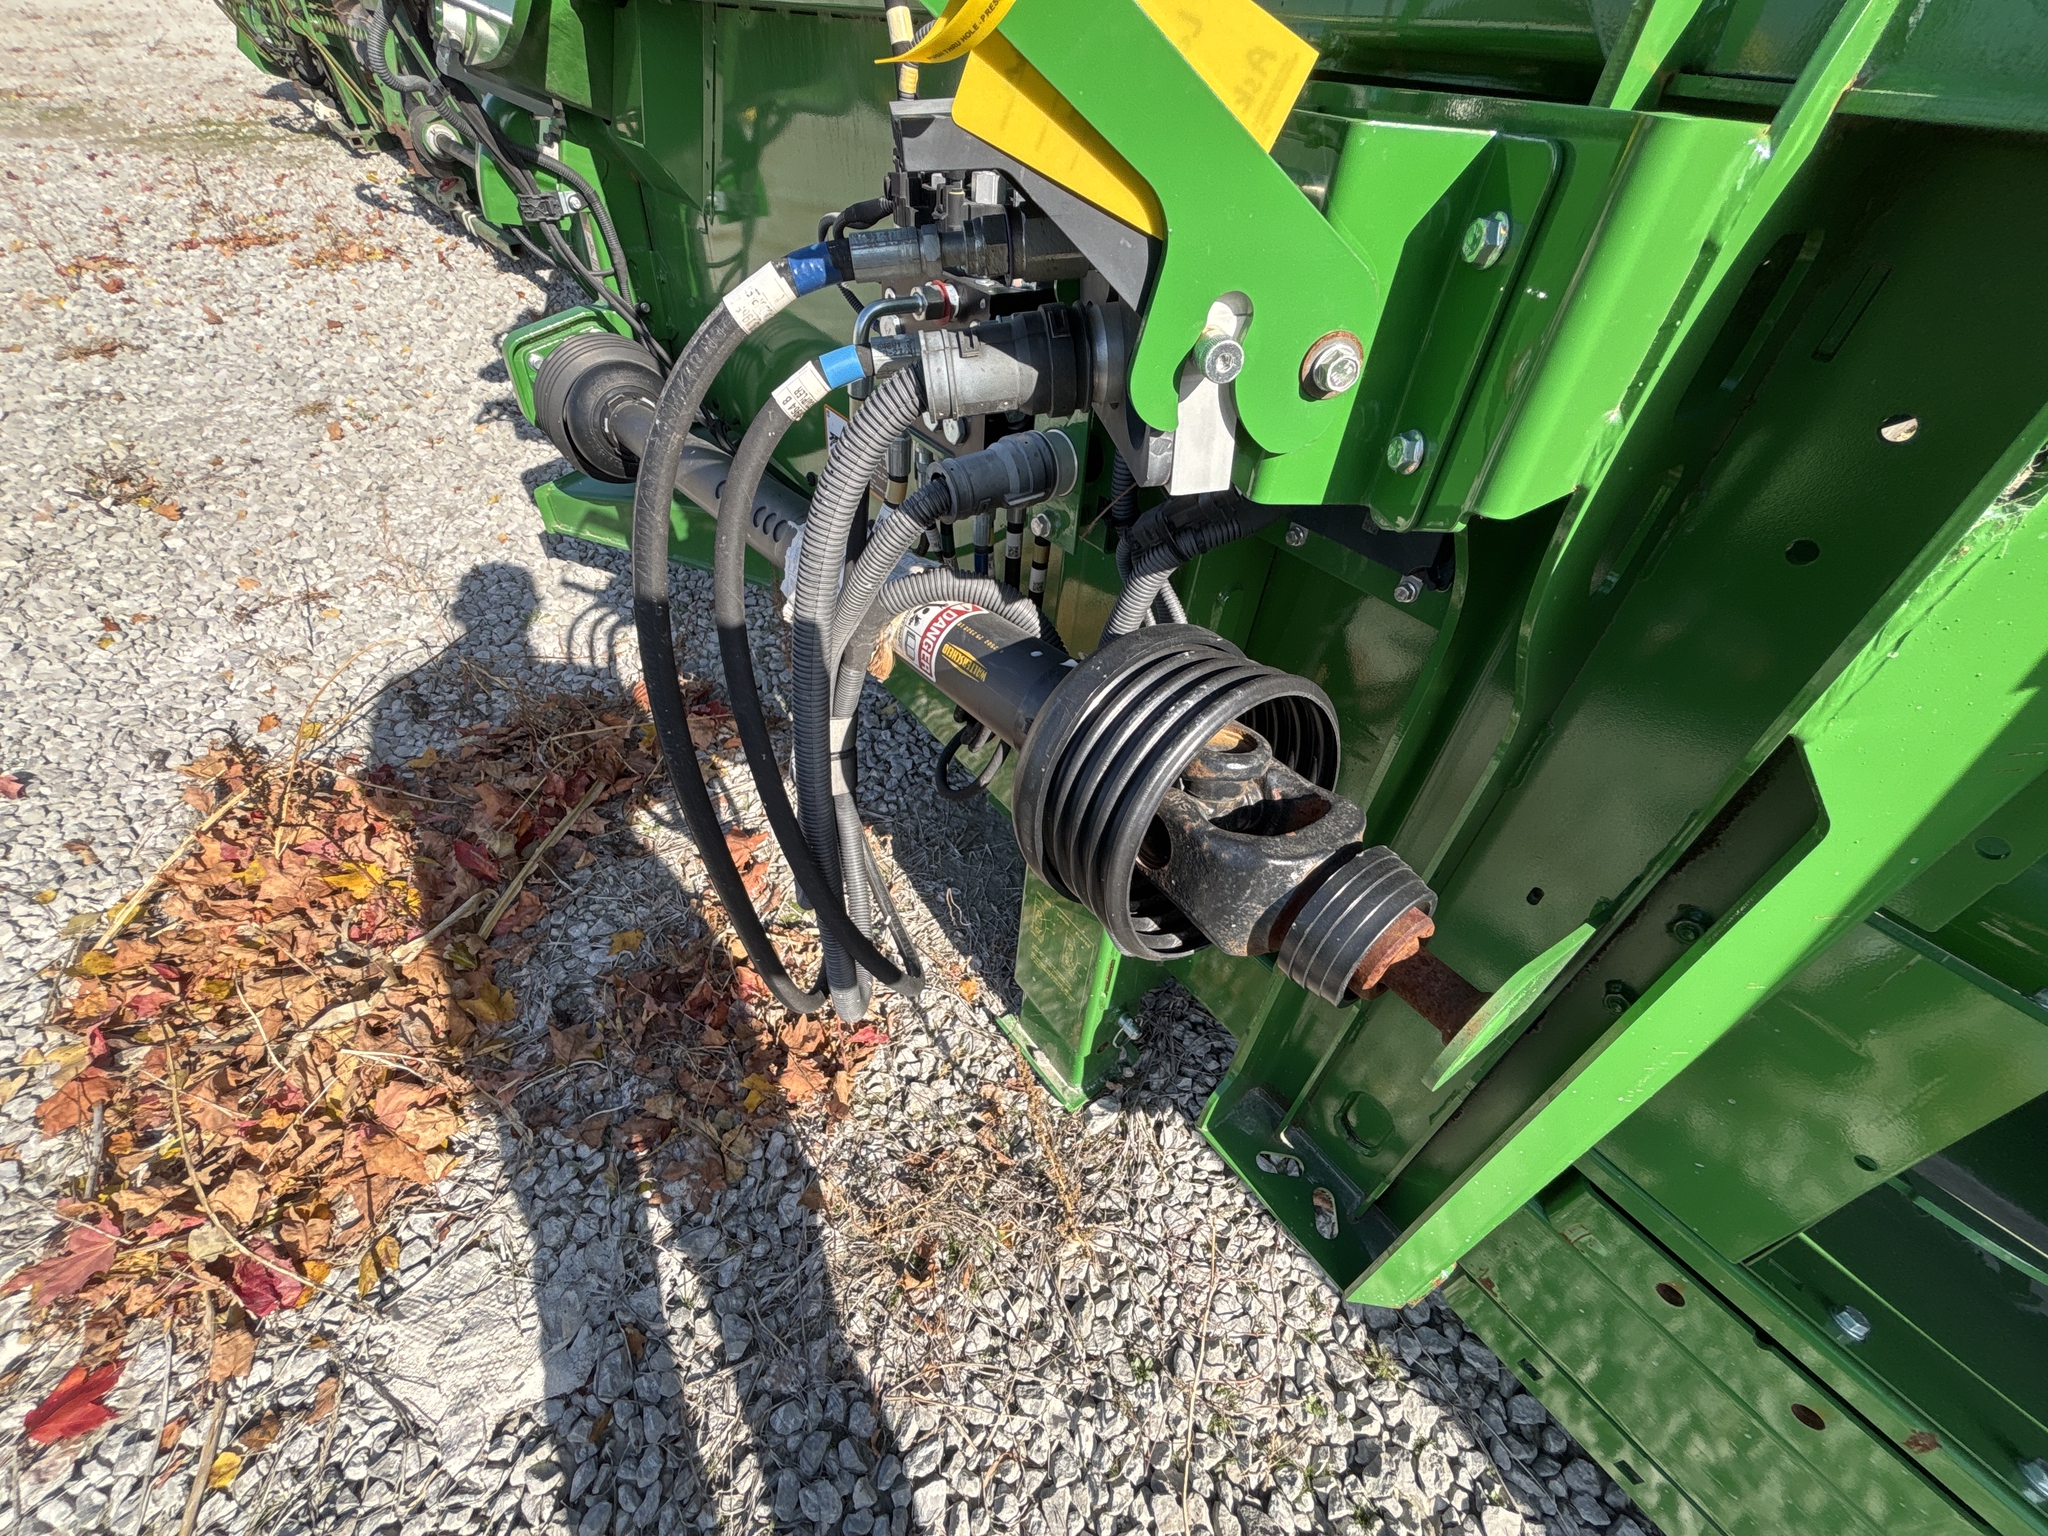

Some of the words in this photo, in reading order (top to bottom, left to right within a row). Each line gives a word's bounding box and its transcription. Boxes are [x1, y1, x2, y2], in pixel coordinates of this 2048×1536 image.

[944, 41, 961, 53] THRU
[960, 23, 979, 42] HOLE
[981, 0, 1000, 22] PRES
[781, 395, 793, 406] B
[920, 609, 958, 675] DANGER
[941, 643, 988, 683] WALTERSCHEID
